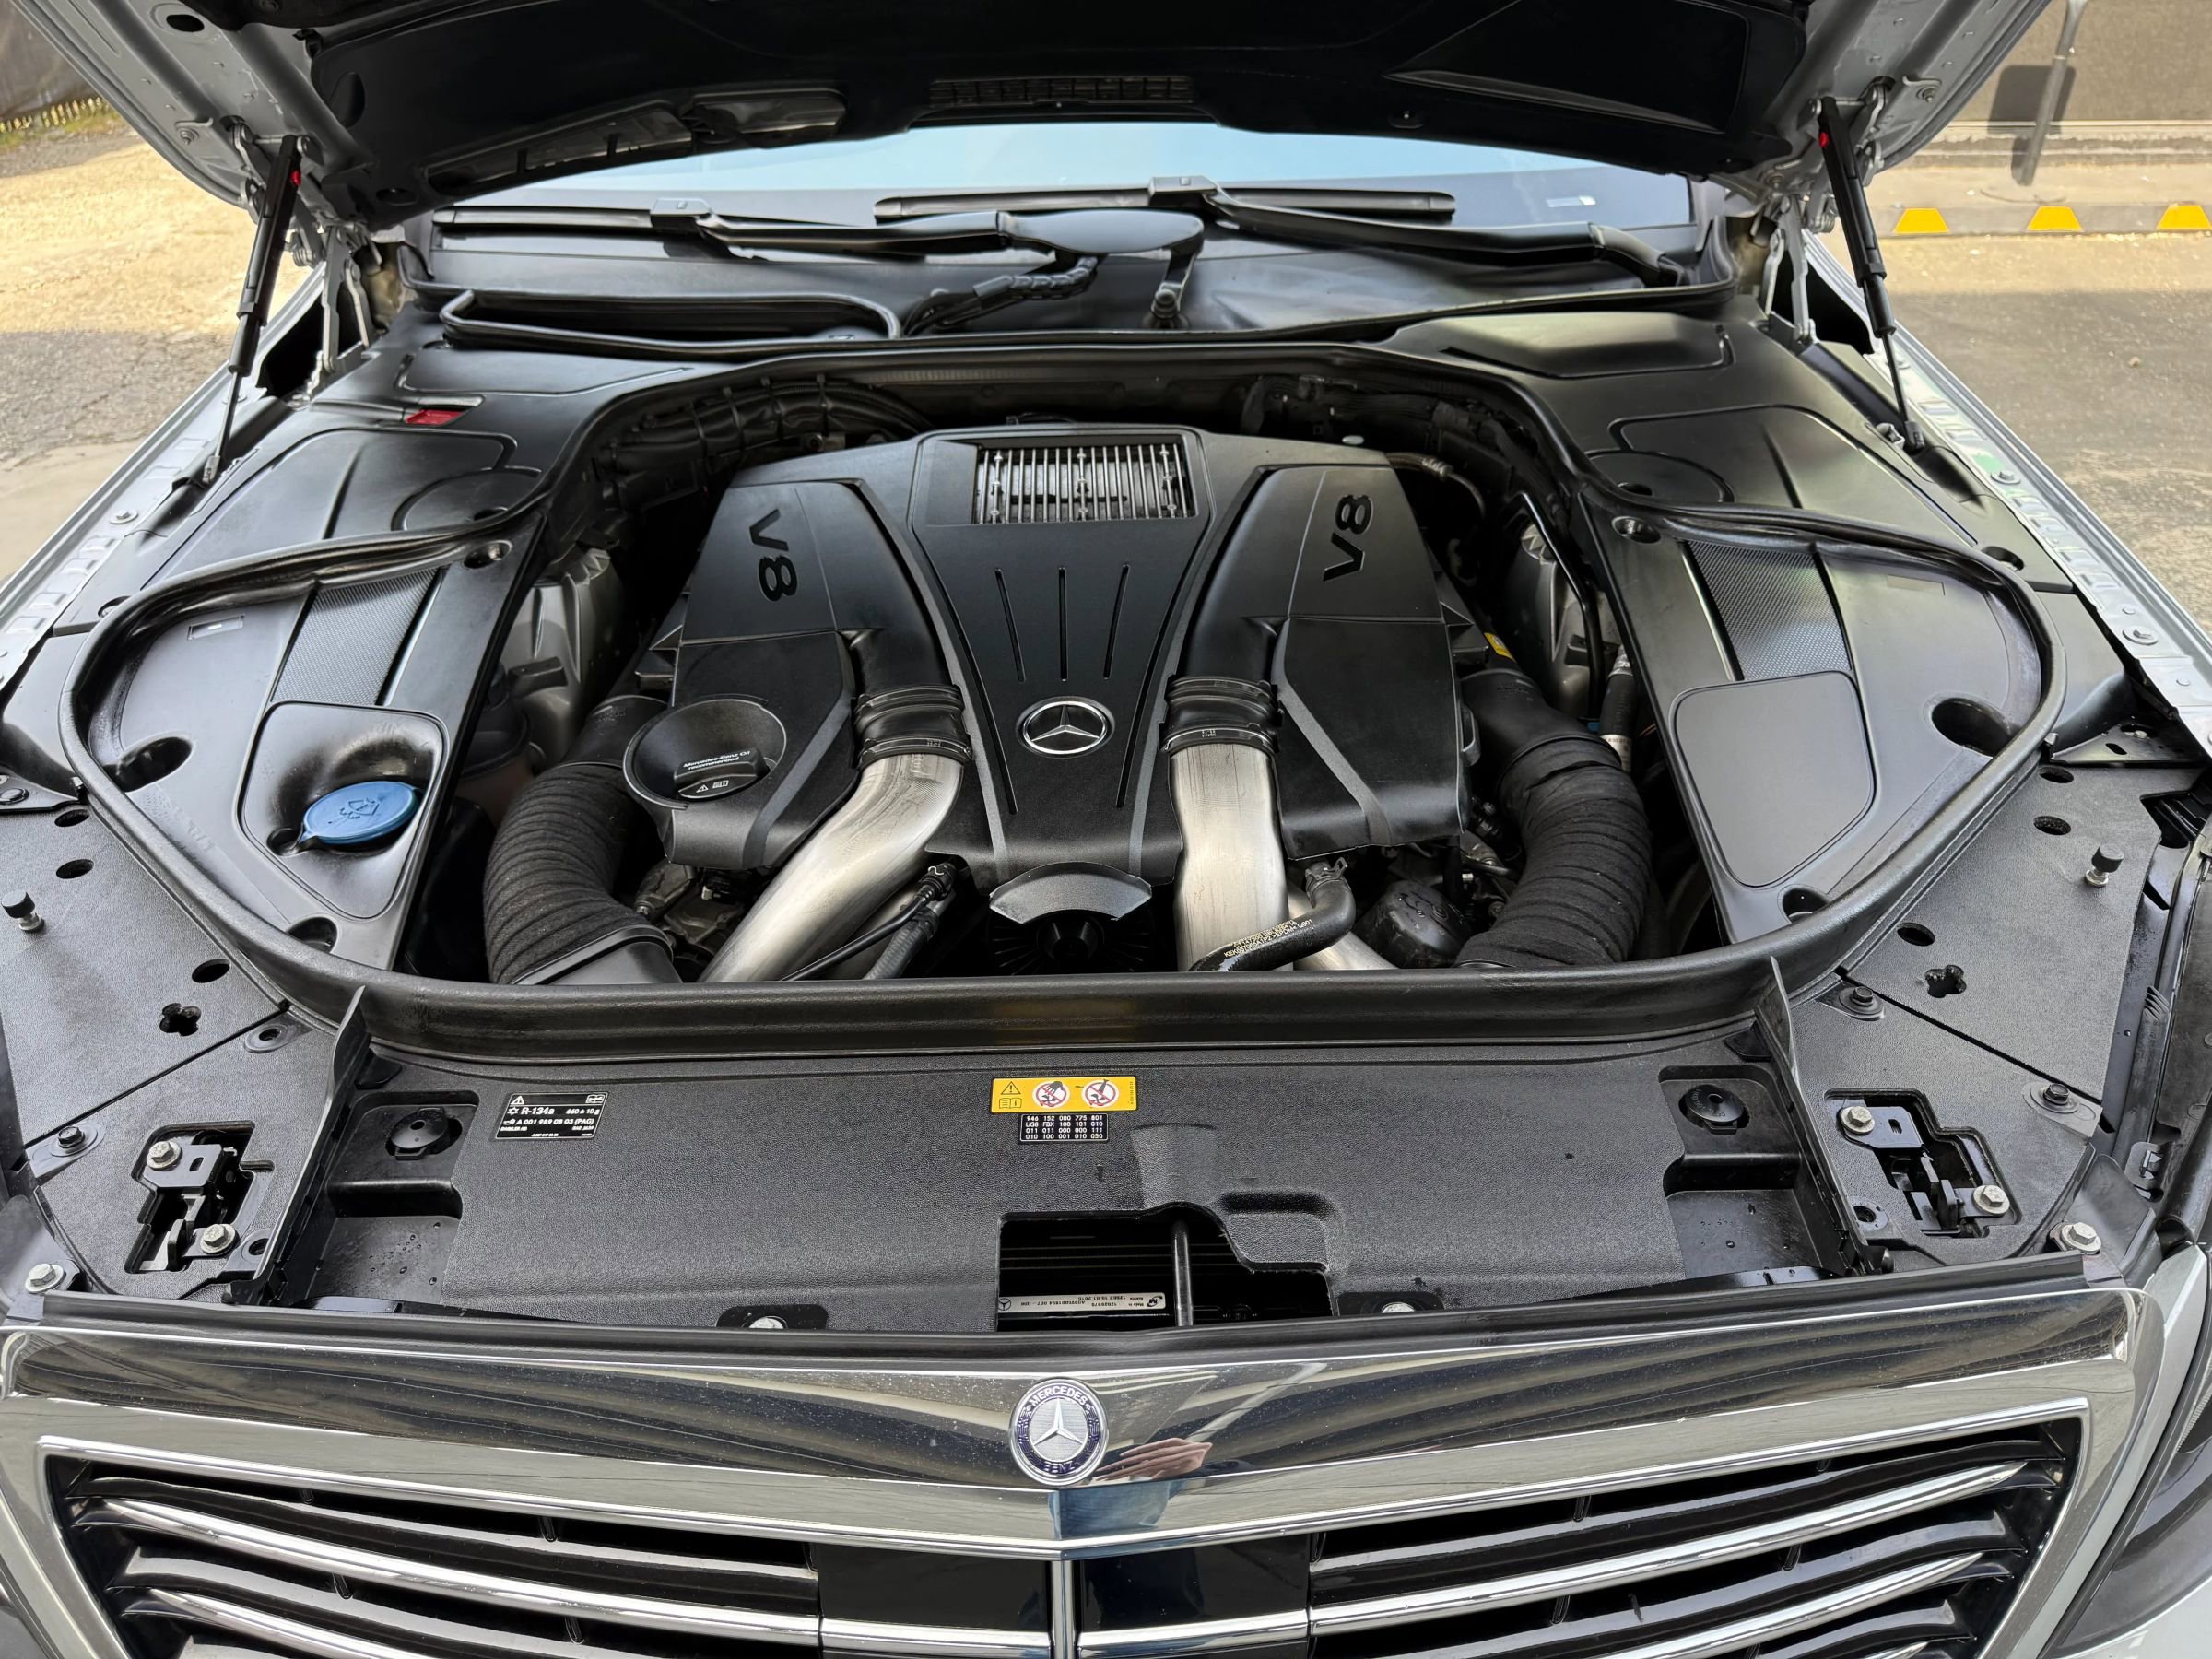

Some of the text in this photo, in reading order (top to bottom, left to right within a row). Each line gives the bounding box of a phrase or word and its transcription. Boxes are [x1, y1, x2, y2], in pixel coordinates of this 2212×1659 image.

[1322, 494, 1374, 582] V8
[749, 508, 798, 601] V8
[683, 753, 738, 767] Mercedes-Benz
[688, 757, 739, 770] recommended
[521, 1107, 555, 1115] R-134a
[1029, 1386, 1088, 1407] MERCEDES
